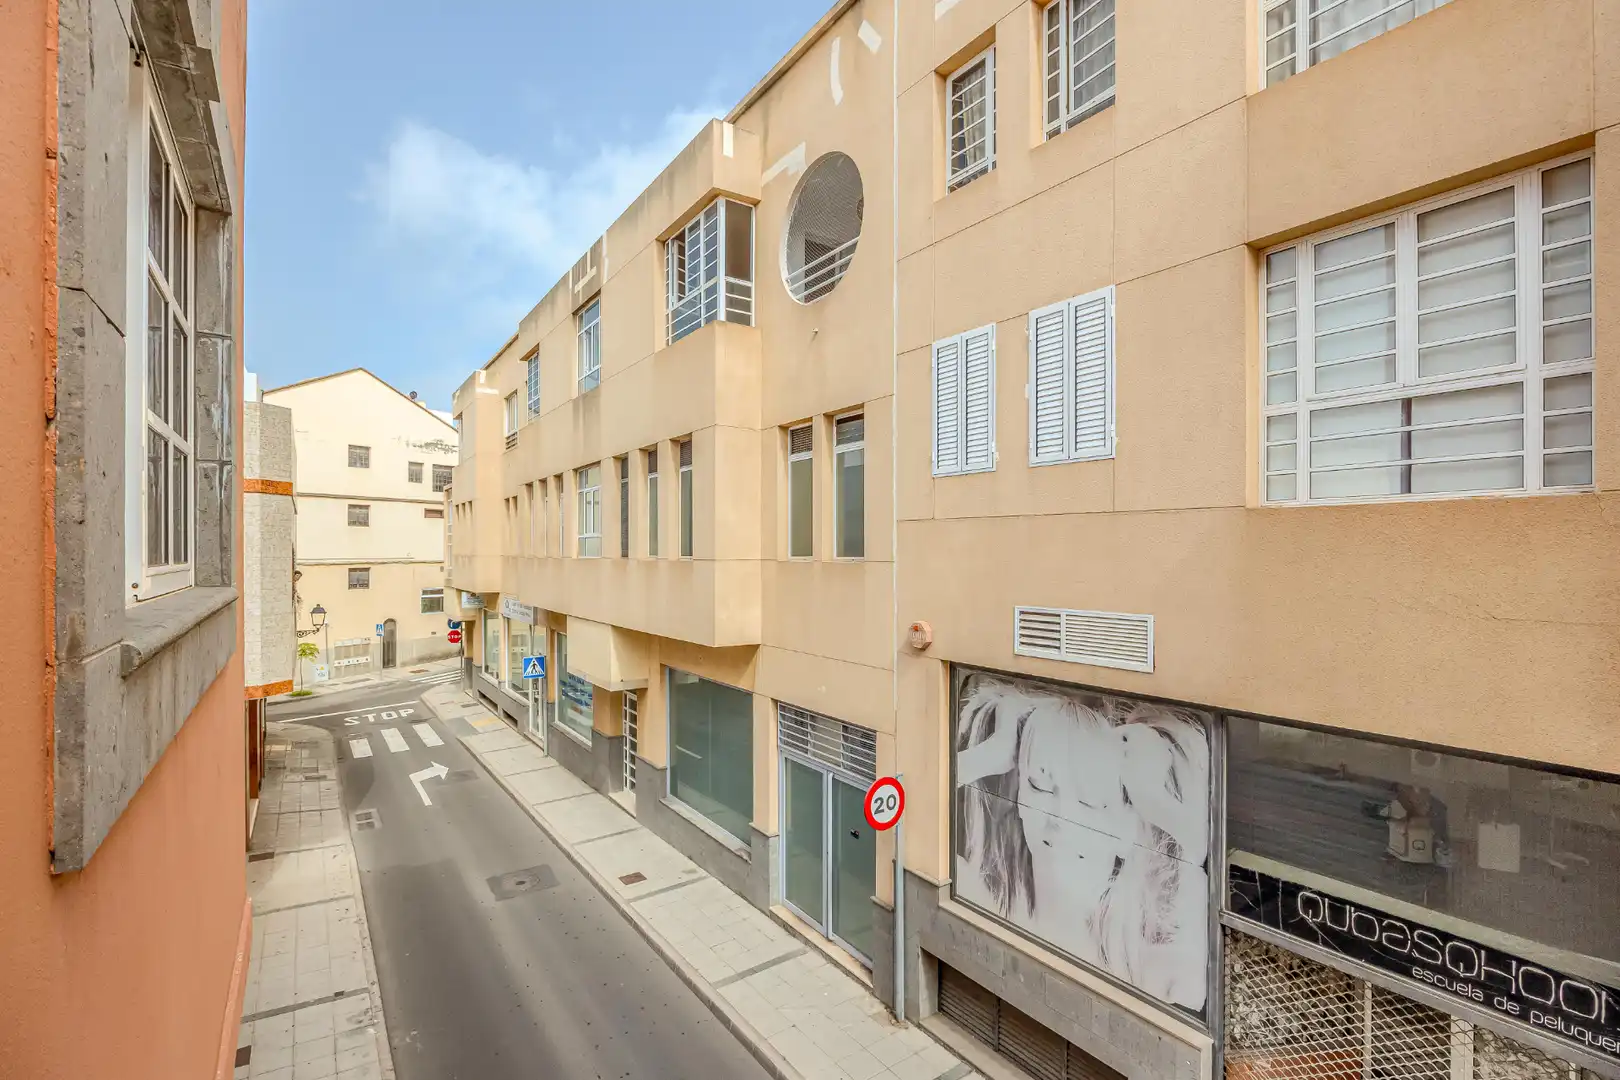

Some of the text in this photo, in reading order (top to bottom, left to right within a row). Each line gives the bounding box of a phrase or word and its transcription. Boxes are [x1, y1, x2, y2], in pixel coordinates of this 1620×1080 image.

[343, 708, 415, 726] STOP
[874, 794, 897, 815] 20
[1412, 966, 1484, 1002] escuela
[1494, 996, 1520, 1015] de
